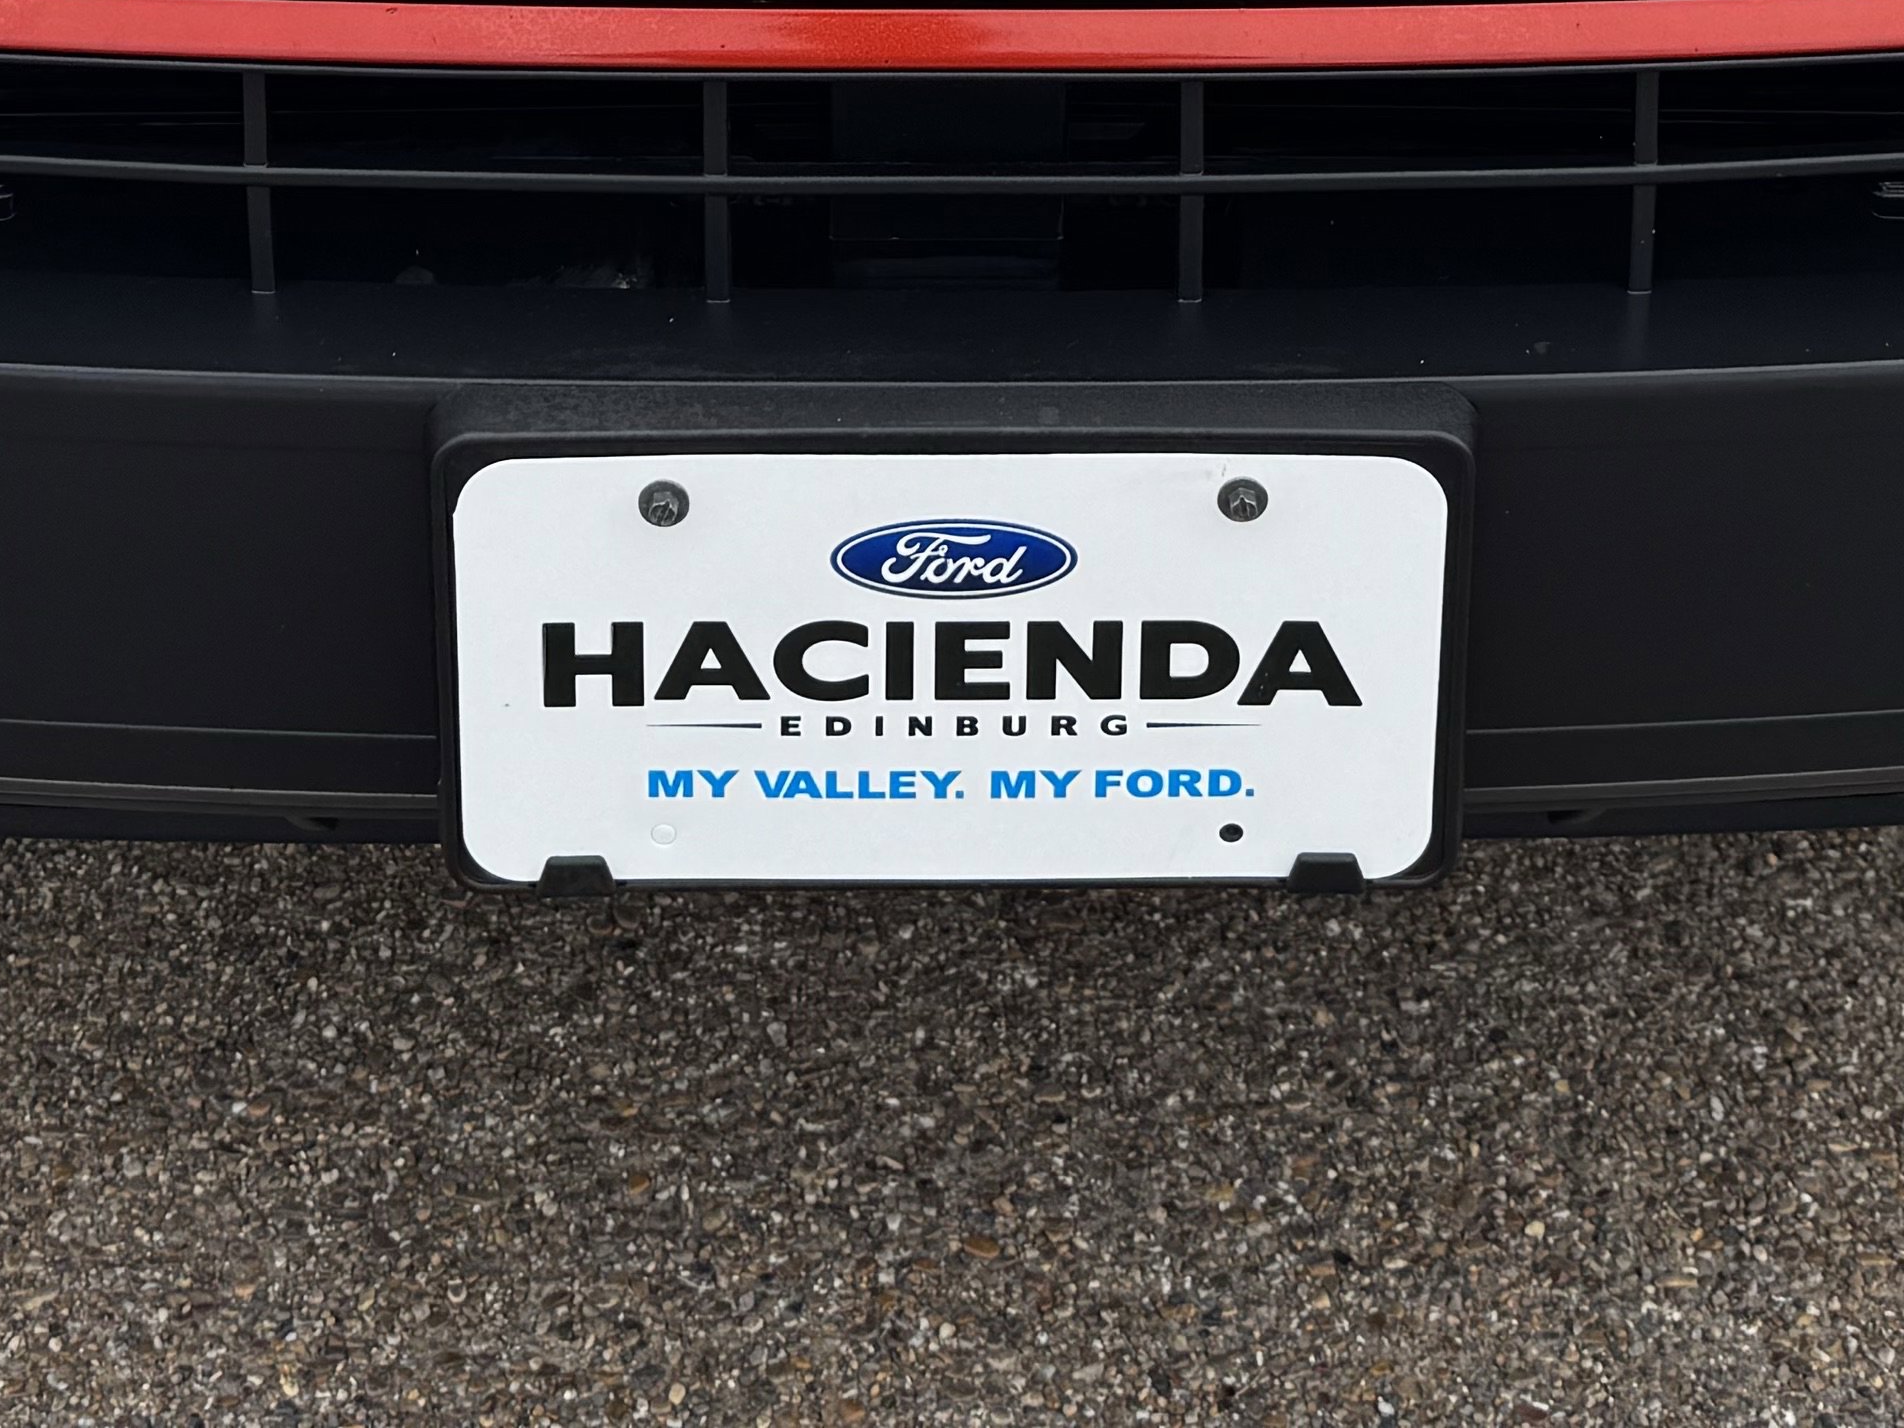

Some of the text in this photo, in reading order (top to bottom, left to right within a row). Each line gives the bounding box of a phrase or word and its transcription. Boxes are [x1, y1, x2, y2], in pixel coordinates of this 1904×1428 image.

[880, 531, 1028, 584] Ford
[542, 620, 1363, 707] HACIENDA
[780, 715, 1128, 737] EDINBURG
[648, 769, 1255, 799] MY VALLEY. MY FORD.
